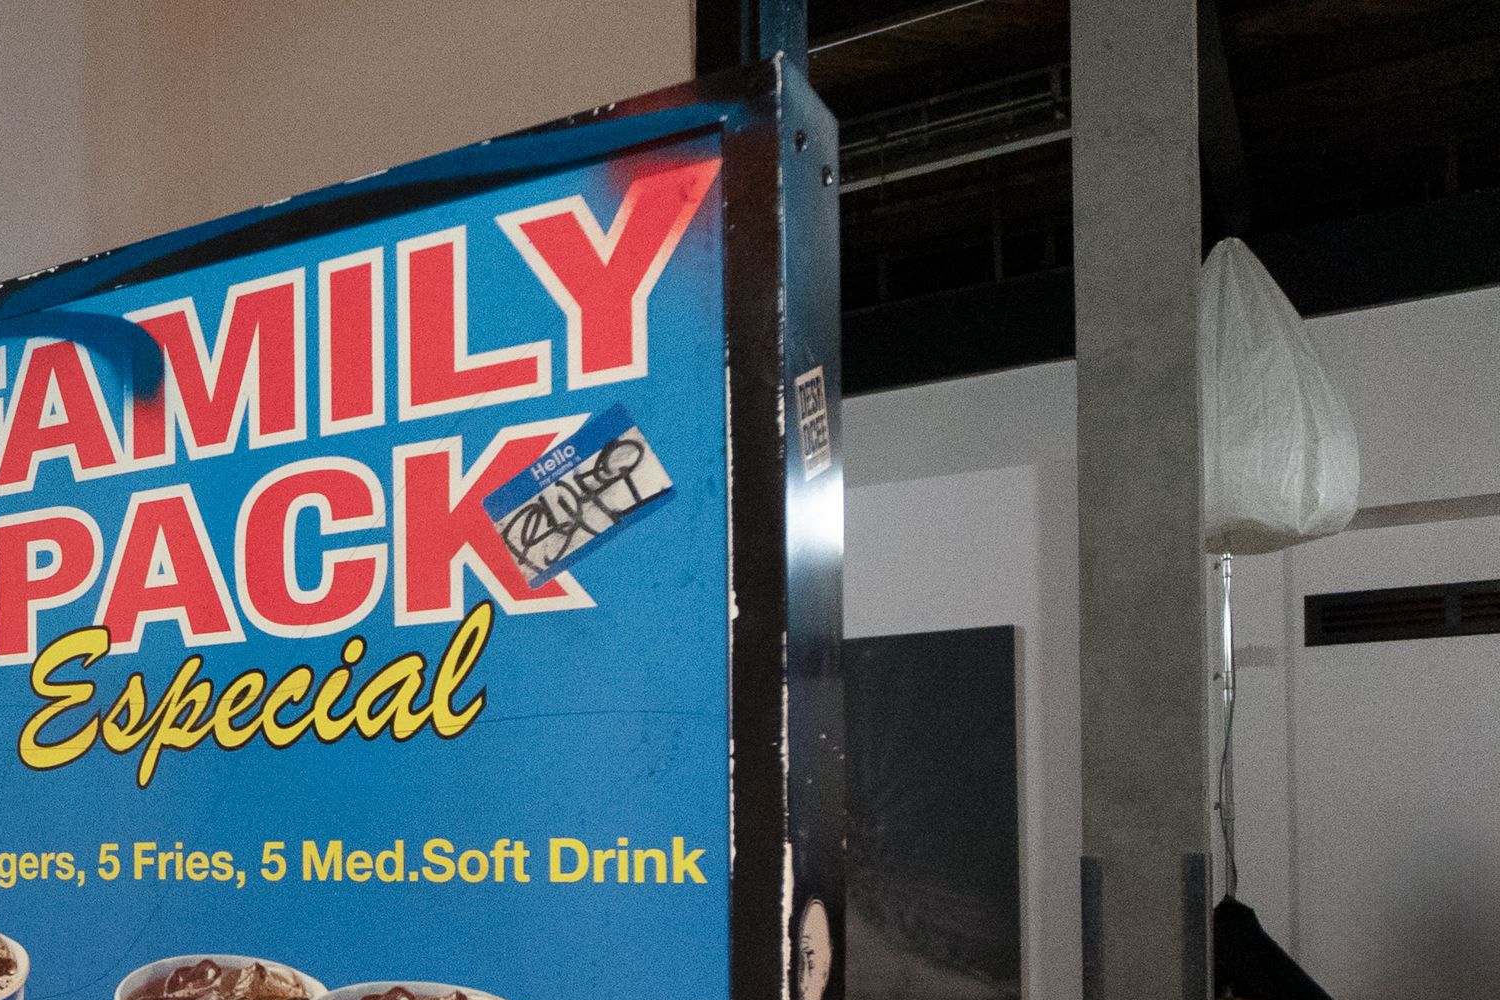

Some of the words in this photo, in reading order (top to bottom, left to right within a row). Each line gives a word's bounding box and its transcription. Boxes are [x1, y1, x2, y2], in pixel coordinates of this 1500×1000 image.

[531, 445, 576, 480] Hello
[17, 600, 488, 790] Especial
[98, 842, 121, 881] 5
[133, 841, 247, 889] Fries,
[260, 841, 288, 881] 5
[549, 836, 709, 884] Drink
